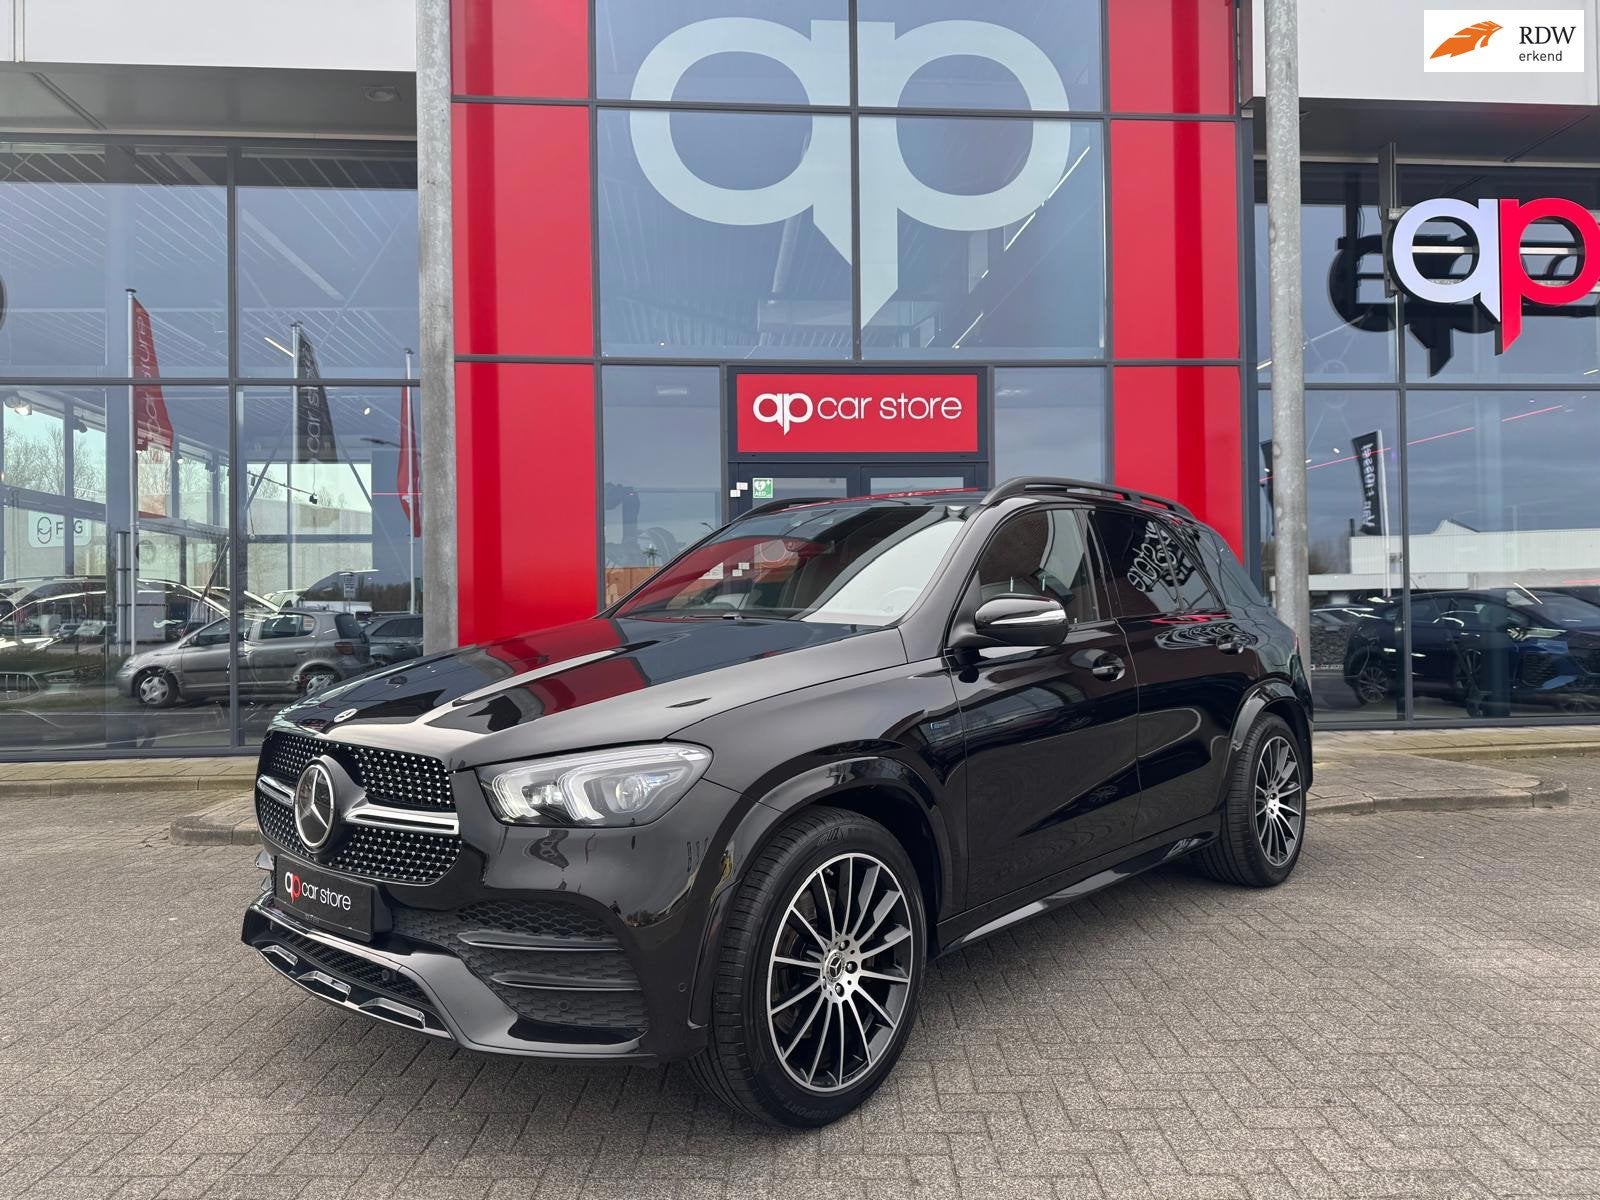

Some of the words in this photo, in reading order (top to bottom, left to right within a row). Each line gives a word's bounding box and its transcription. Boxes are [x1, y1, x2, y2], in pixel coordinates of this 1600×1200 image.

[752, 392, 813, 436] ap
[816, 396, 872, 420] car
[879, 392, 963, 420] store
[285, 871, 302, 903] ap
[301, 882, 319, 900] car
[319, 887, 351, 911] store
